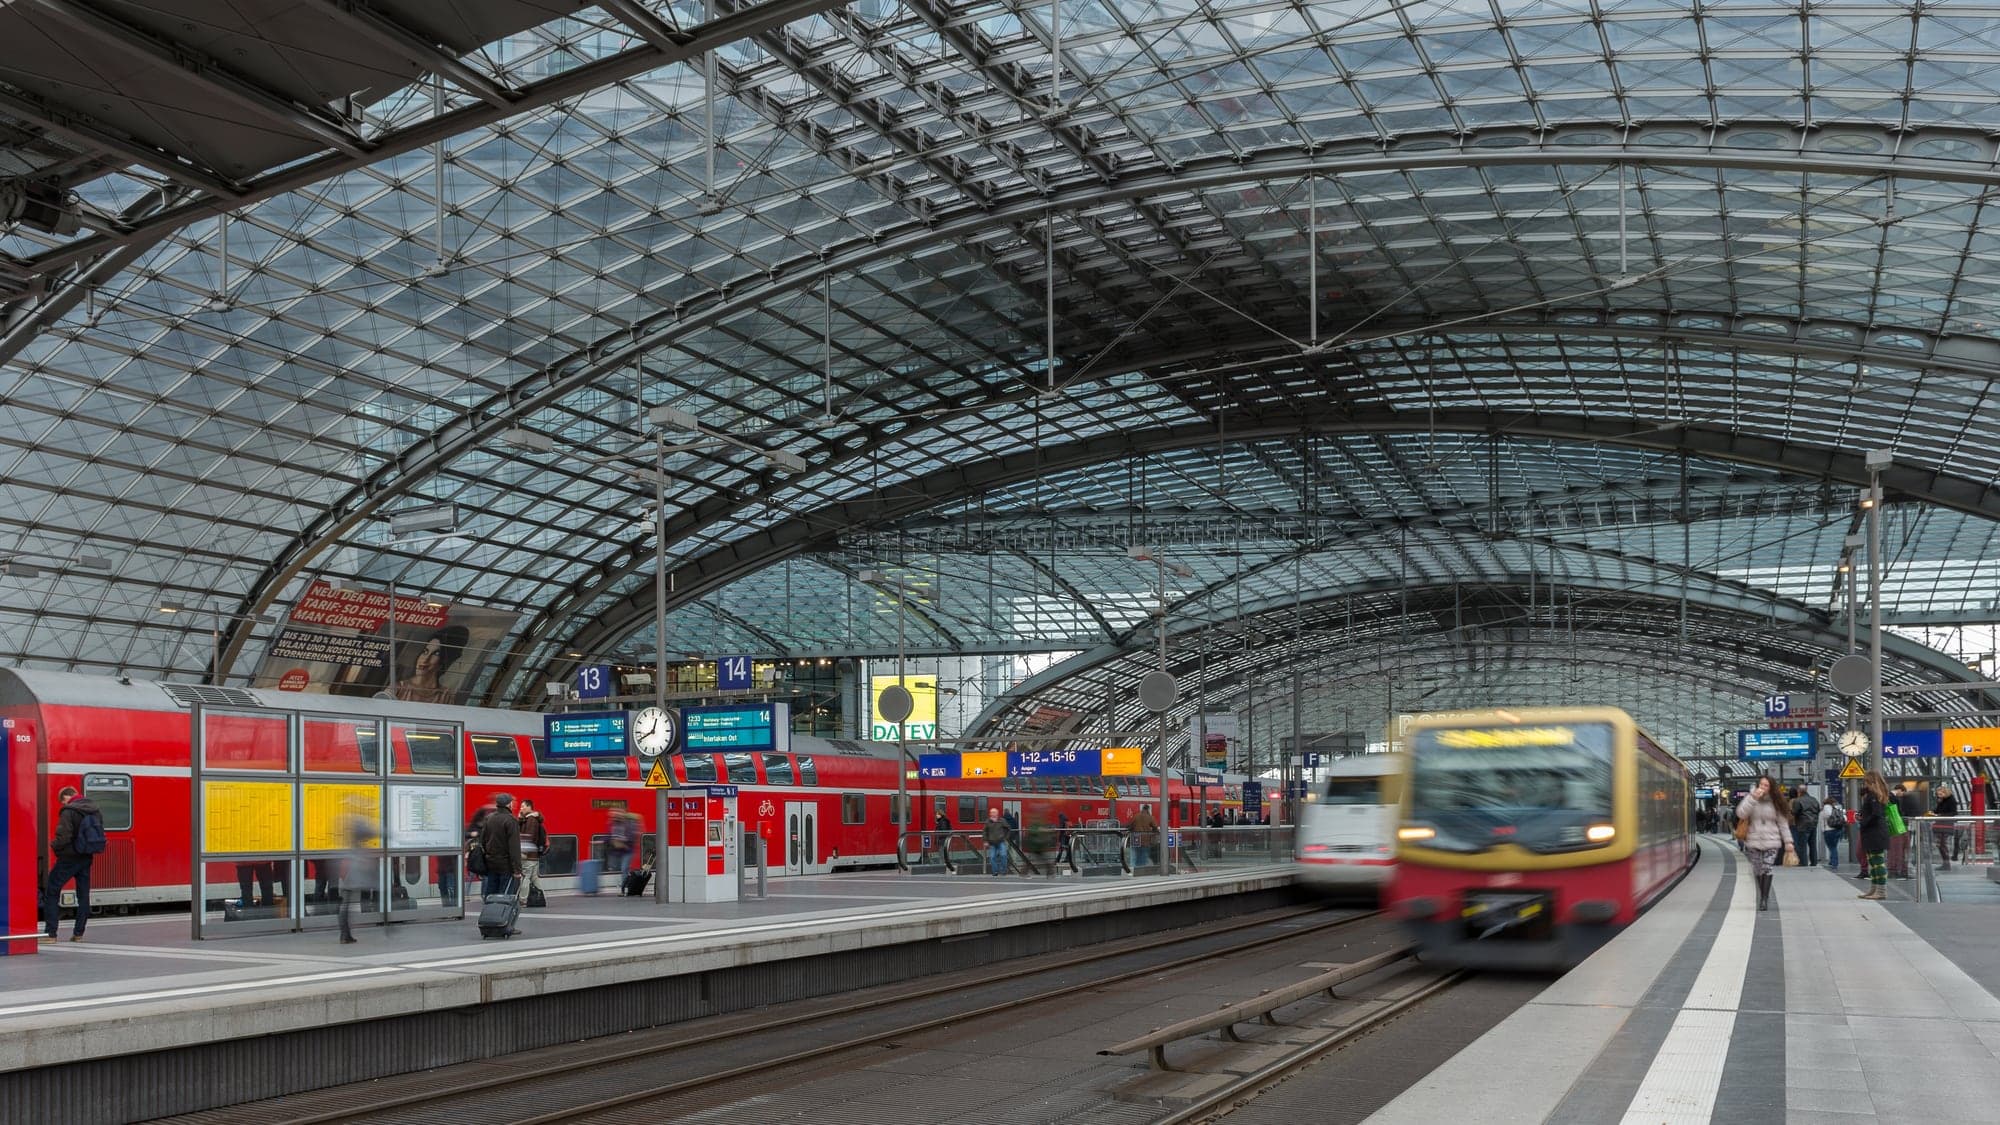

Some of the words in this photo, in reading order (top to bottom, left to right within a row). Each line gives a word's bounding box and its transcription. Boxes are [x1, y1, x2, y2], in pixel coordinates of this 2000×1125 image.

[311, 586, 341, 598] NEU!
[340, 588, 364, 602] DER
[368, 594, 390, 606] HRS
[294, 610, 324, 622] MAN
[325, 614, 376, 630] GÜNSTIG.
[304, 598, 342, 612] TARIF:
[342, 604, 359, 614] SO
[406, 613, 443, 627] BUCHT
[278, 640, 306, 650] WLAN
[306, 644, 326, 652] UND
[325, 646, 379, 658] KOSTENLOSE
[283, 631, 298, 640] BIS
[299, 632, 311, 642] ZU
[363, 641, 391, 651] GRATIS
[272, 648, 336, 662] STORNIERUNG
[336, 654, 352, 664] BIS
[725, 657, 746, 680] 14
[580, 668, 600, 690] 13
[1766, 696, 1786, 712] 15
[760, 710, 770, 722] 14
[550, 720, 560, 732] 13
[1020, 752, 1040, 762] 1-12
[1050, 751, 1076, 762] 15-16
[1309, 753, 1317, 765] F
